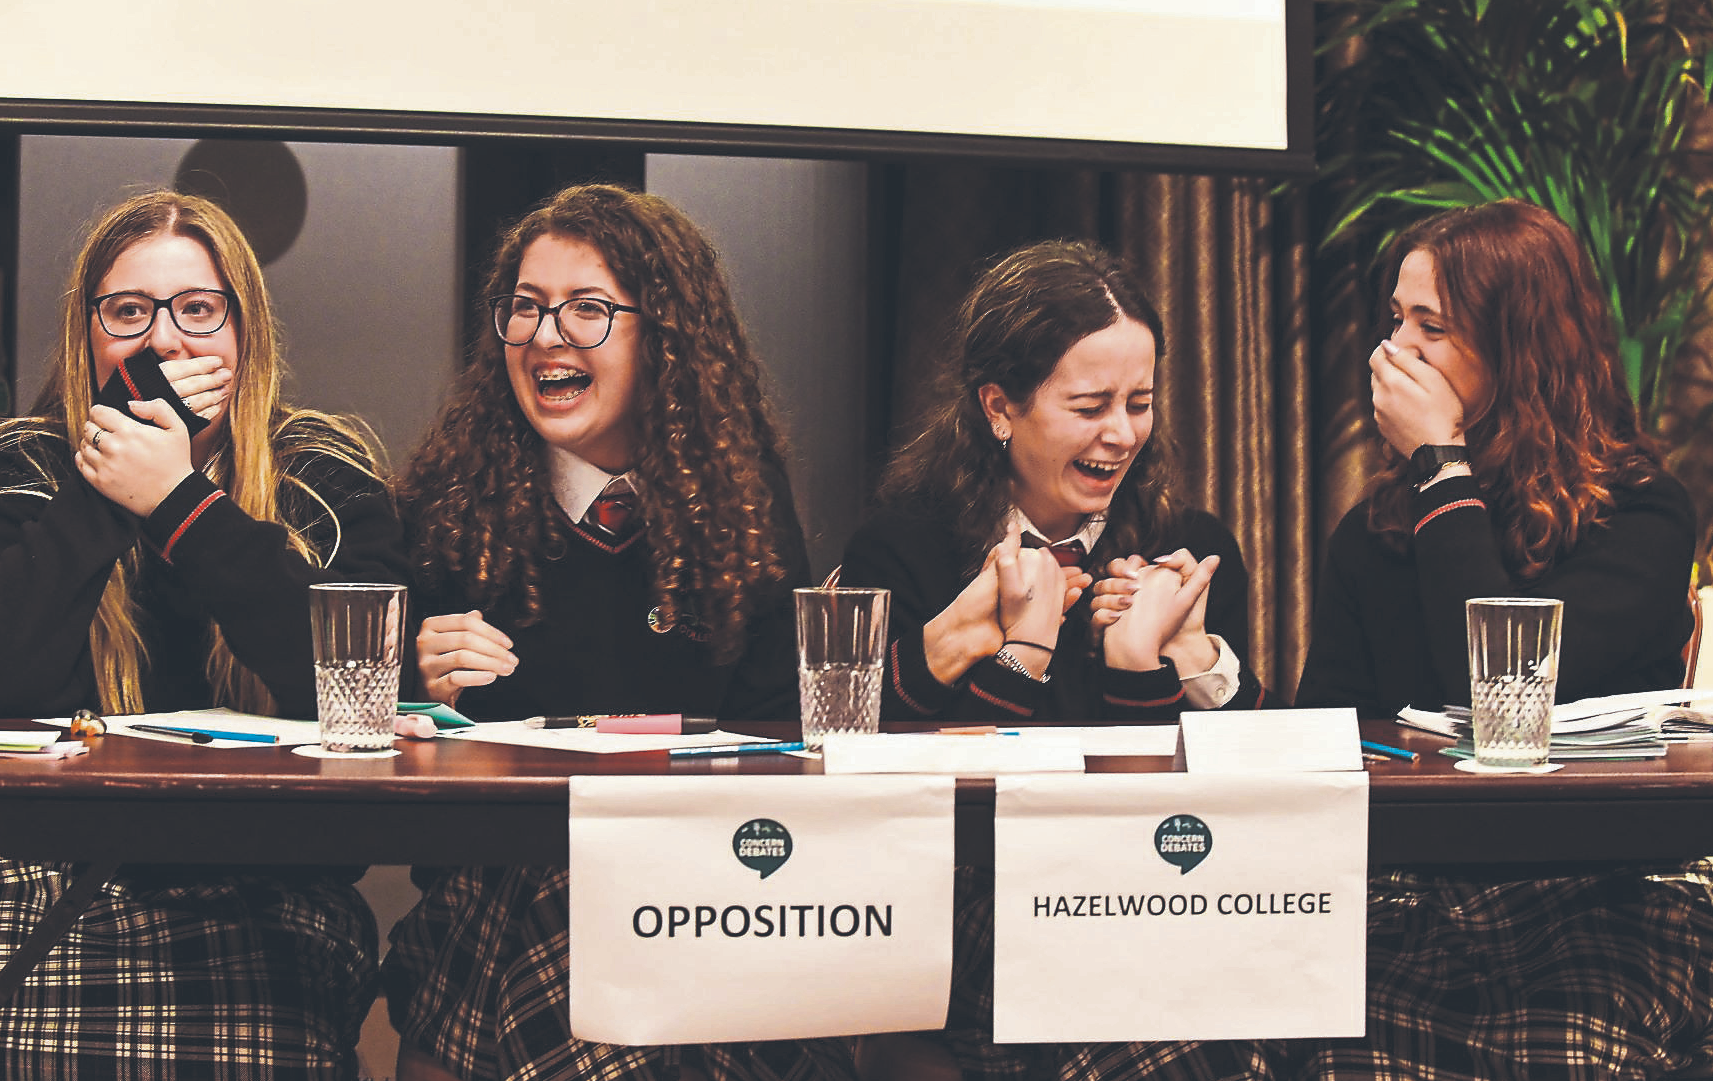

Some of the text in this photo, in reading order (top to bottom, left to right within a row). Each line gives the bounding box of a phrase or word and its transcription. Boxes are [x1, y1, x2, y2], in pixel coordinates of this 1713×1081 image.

[739, 838, 785, 847] CONCERN
[1161, 834, 1205, 843] CONCERN
[738, 847, 786, 857] DEBATES
[1160, 843, 1206, 853] DEBATES
[1033, 892, 1332, 917] HAZELWOOD COLLEGE
[632, 904, 892, 938] OPPOSITION
